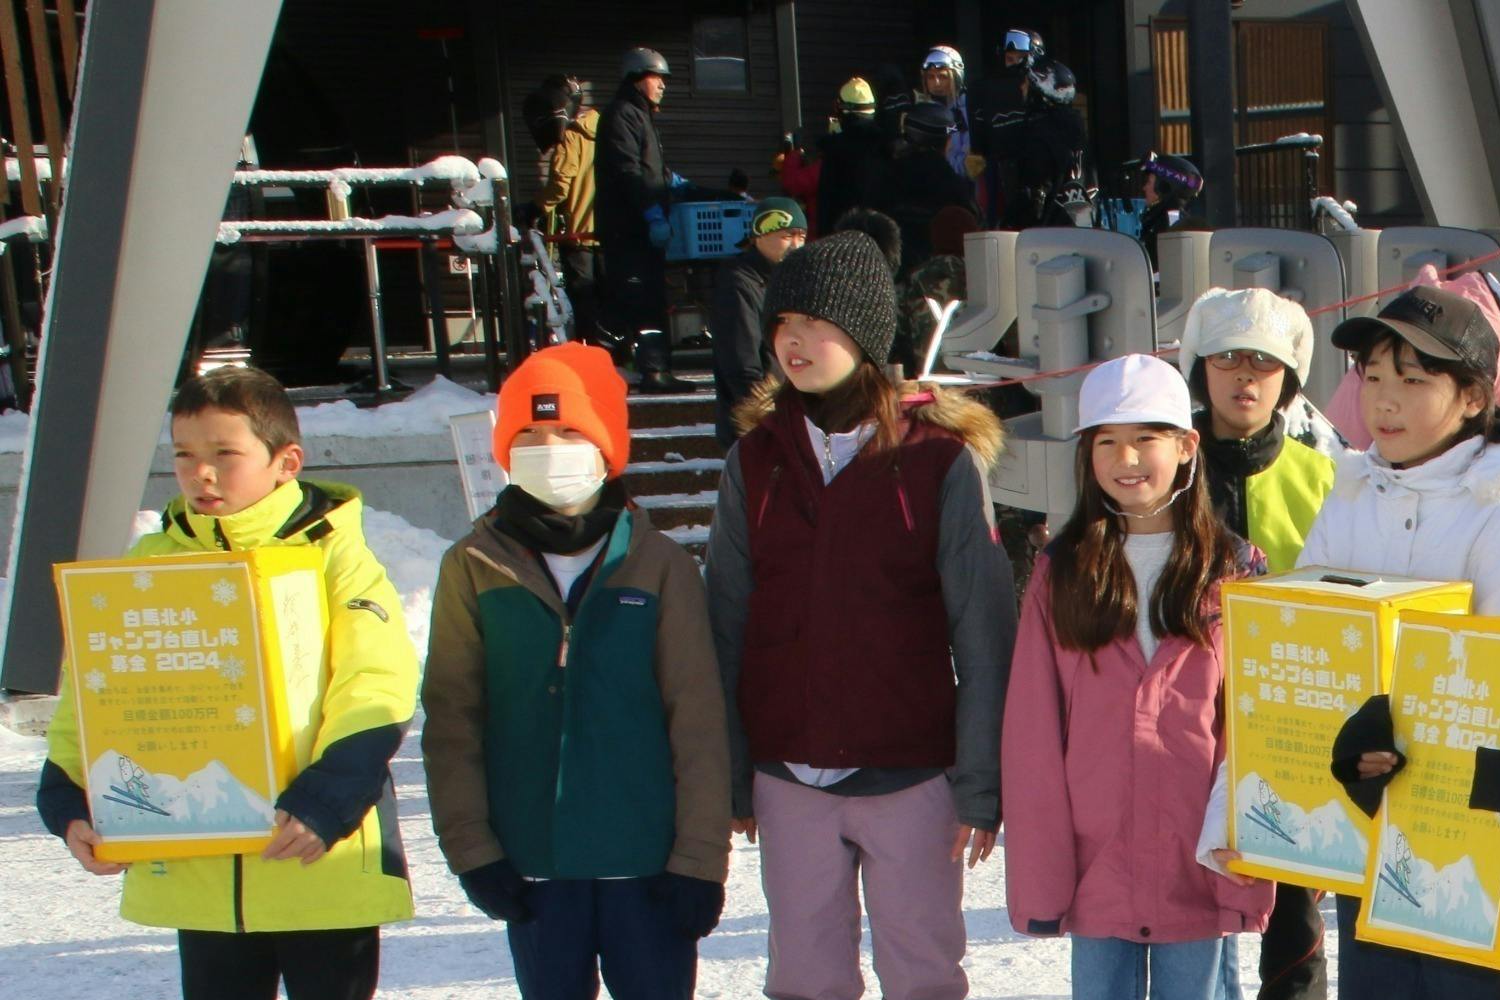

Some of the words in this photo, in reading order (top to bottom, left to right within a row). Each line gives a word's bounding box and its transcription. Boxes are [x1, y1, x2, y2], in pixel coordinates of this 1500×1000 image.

[123, 607, 198, 628] 白馬北小
[87, 627, 240, 652] ジャンプ台直し隊
[110, 654, 147, 673] 募金
[155, 651, 221, 672] 2024
[1270, 642, 1330, 666] 白馬北小
[1242, 658, 1362, 693] ジャンプ台直し隊
[1258, 682, 1287, 704] 募金
[1294, 687, 1346, 712] 2024
[1412, 721, 1441, 745] 募金
